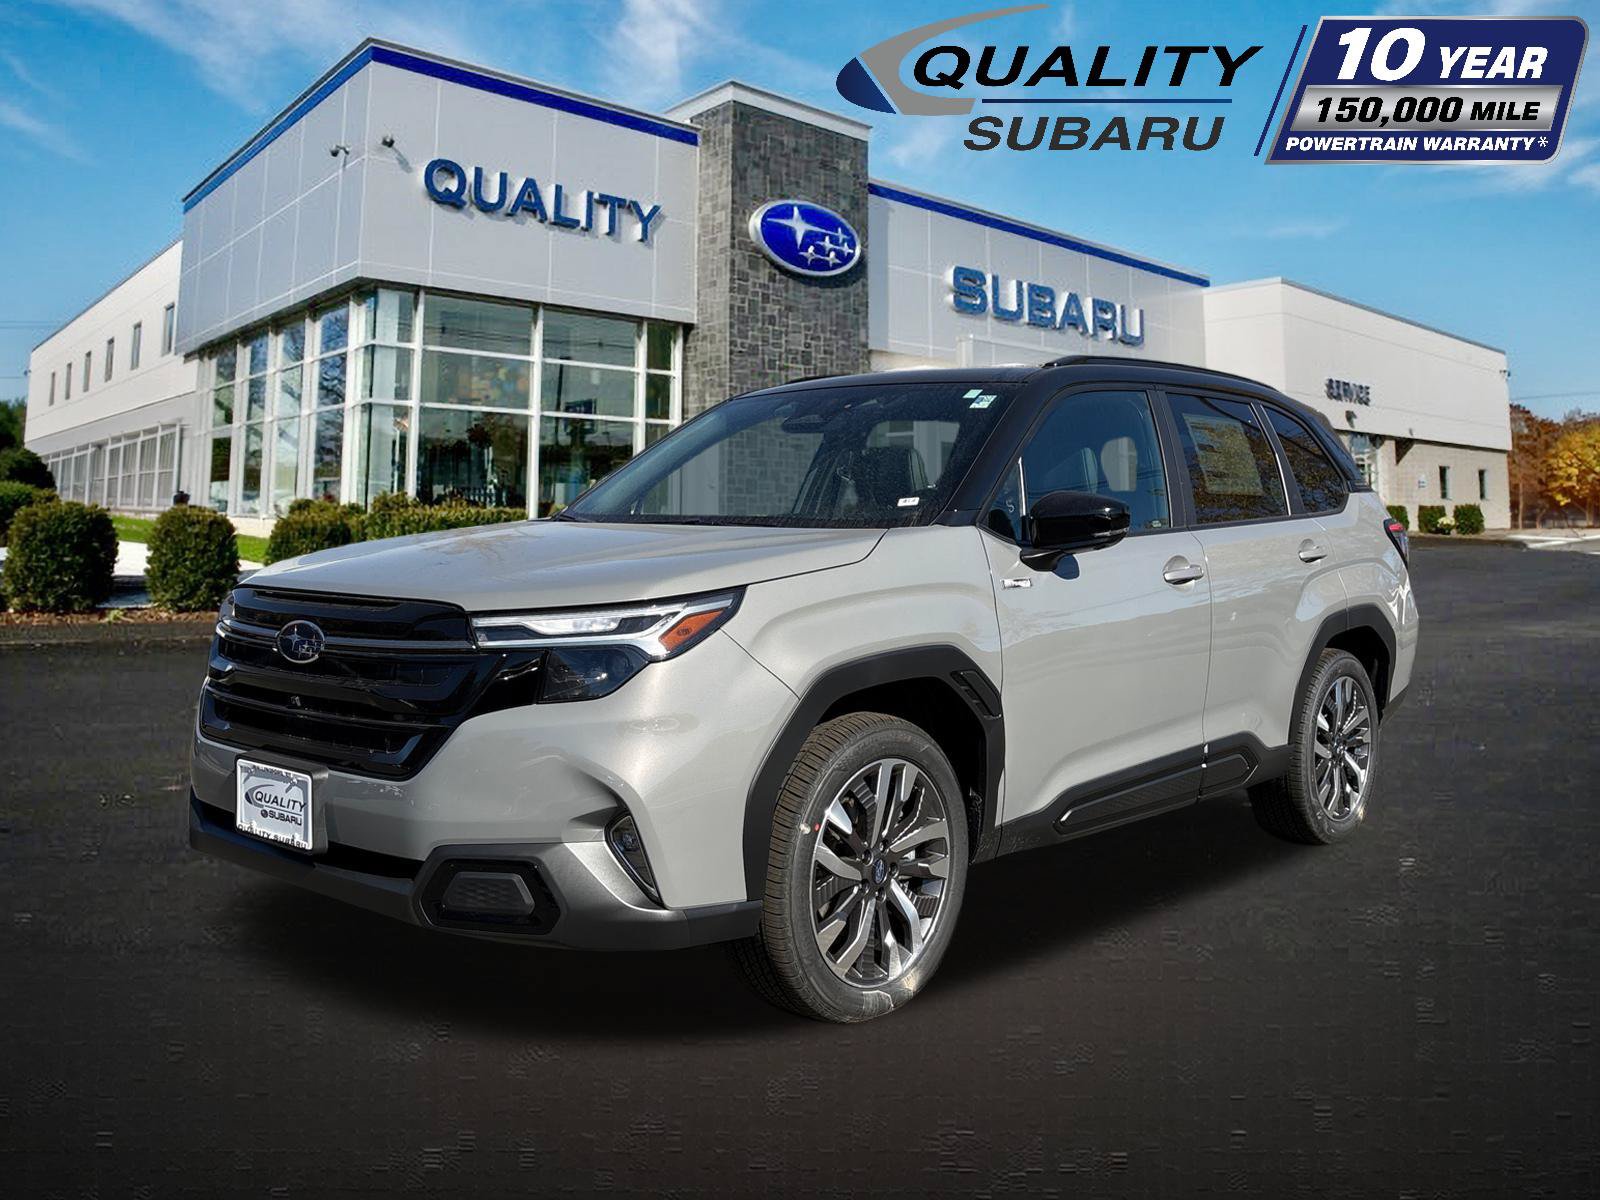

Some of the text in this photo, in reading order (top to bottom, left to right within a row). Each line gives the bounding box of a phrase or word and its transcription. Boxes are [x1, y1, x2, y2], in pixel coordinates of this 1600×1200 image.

[424, 158, 662, 243] QUALITY
[951, 265, 1145, 347] SUBARU
[255, 791, 308, 812] QUALITY
[268, 810, 303, 826] SUBARU
